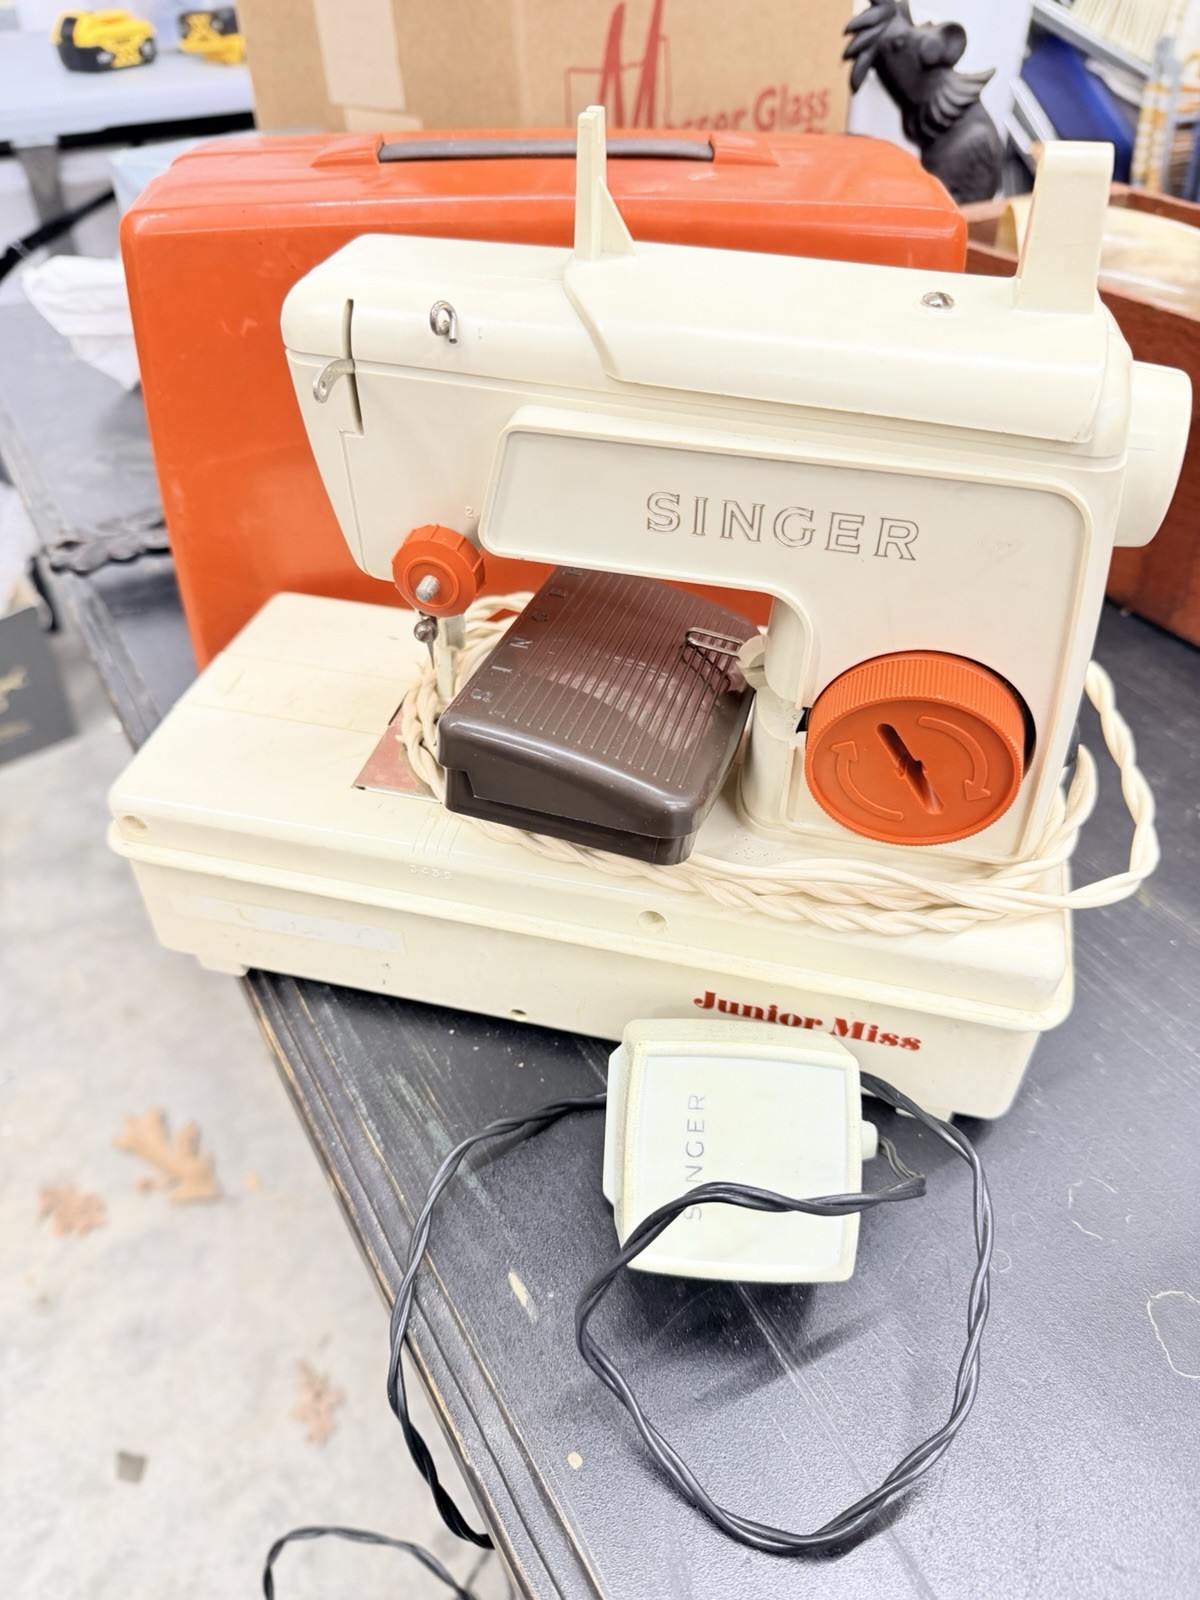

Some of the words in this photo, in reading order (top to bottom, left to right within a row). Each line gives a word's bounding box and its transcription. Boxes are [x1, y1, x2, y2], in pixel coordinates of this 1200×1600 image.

[753, 83, 829, 133] Glass
[465, 505, 475, 519] 2
[646, 491, 919, 561] SINGER
[693, 991, 823, 1030] Junior
[828, 1017, 922, 1051] Miss
[683, 1094, 707, 1222] SNGER
